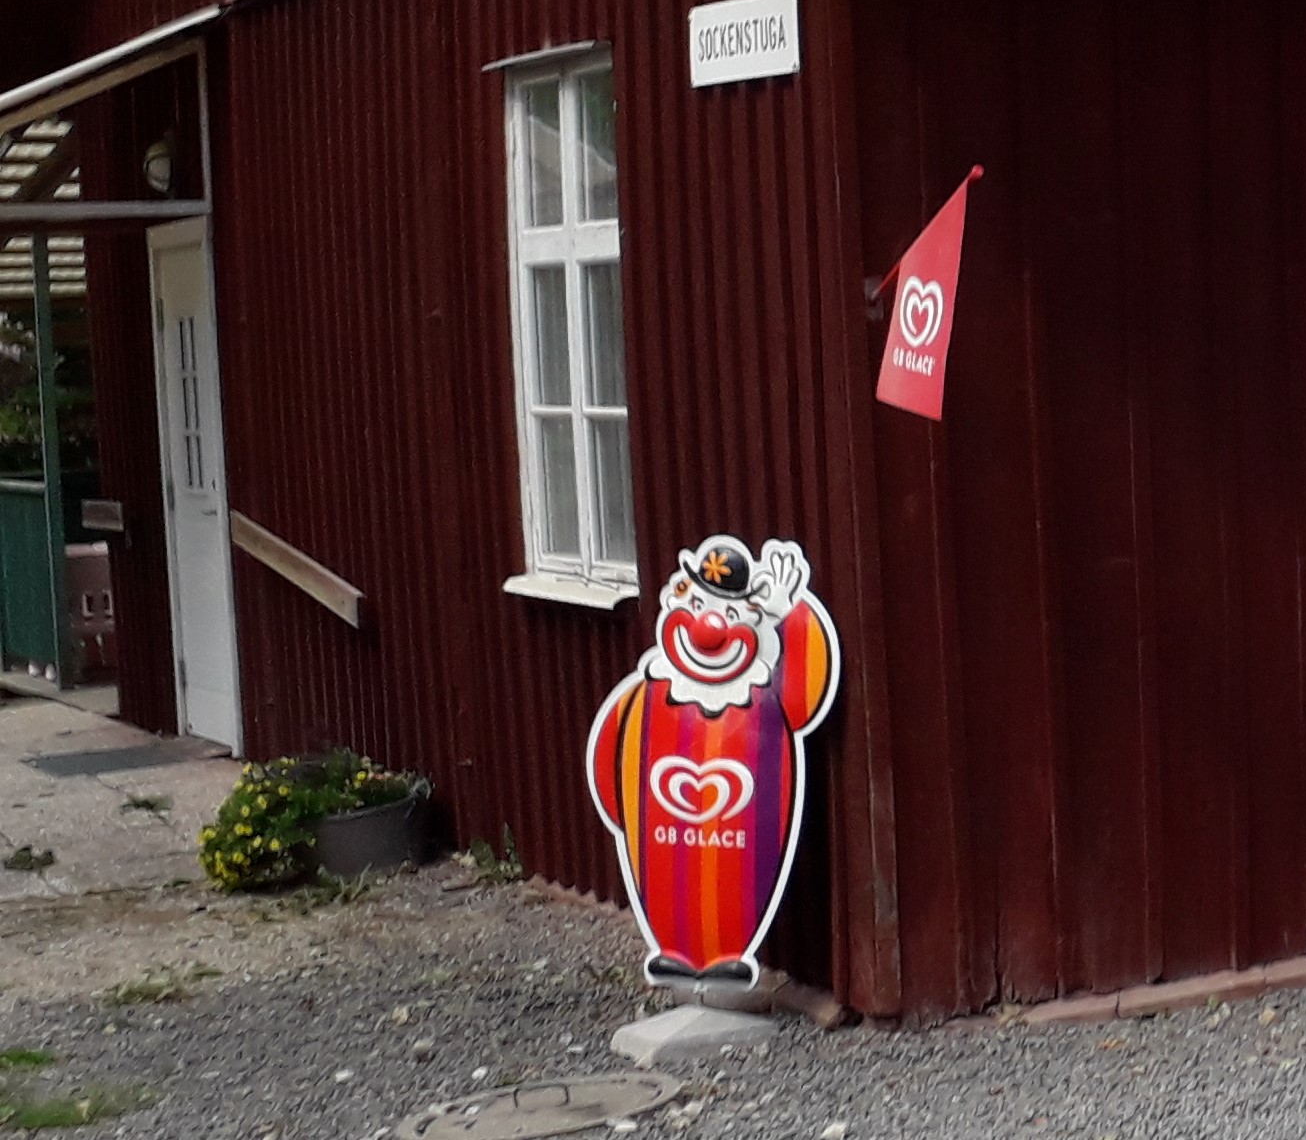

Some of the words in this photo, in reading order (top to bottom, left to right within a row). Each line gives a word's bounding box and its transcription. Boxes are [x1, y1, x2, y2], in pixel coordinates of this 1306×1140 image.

[698, 14, 787, 63] SOCKENSTUGA
[905, 349, 936, 377] GLACE
[654, 824, 677, 846] GB
[683, 827, 747, 850] GLACE
